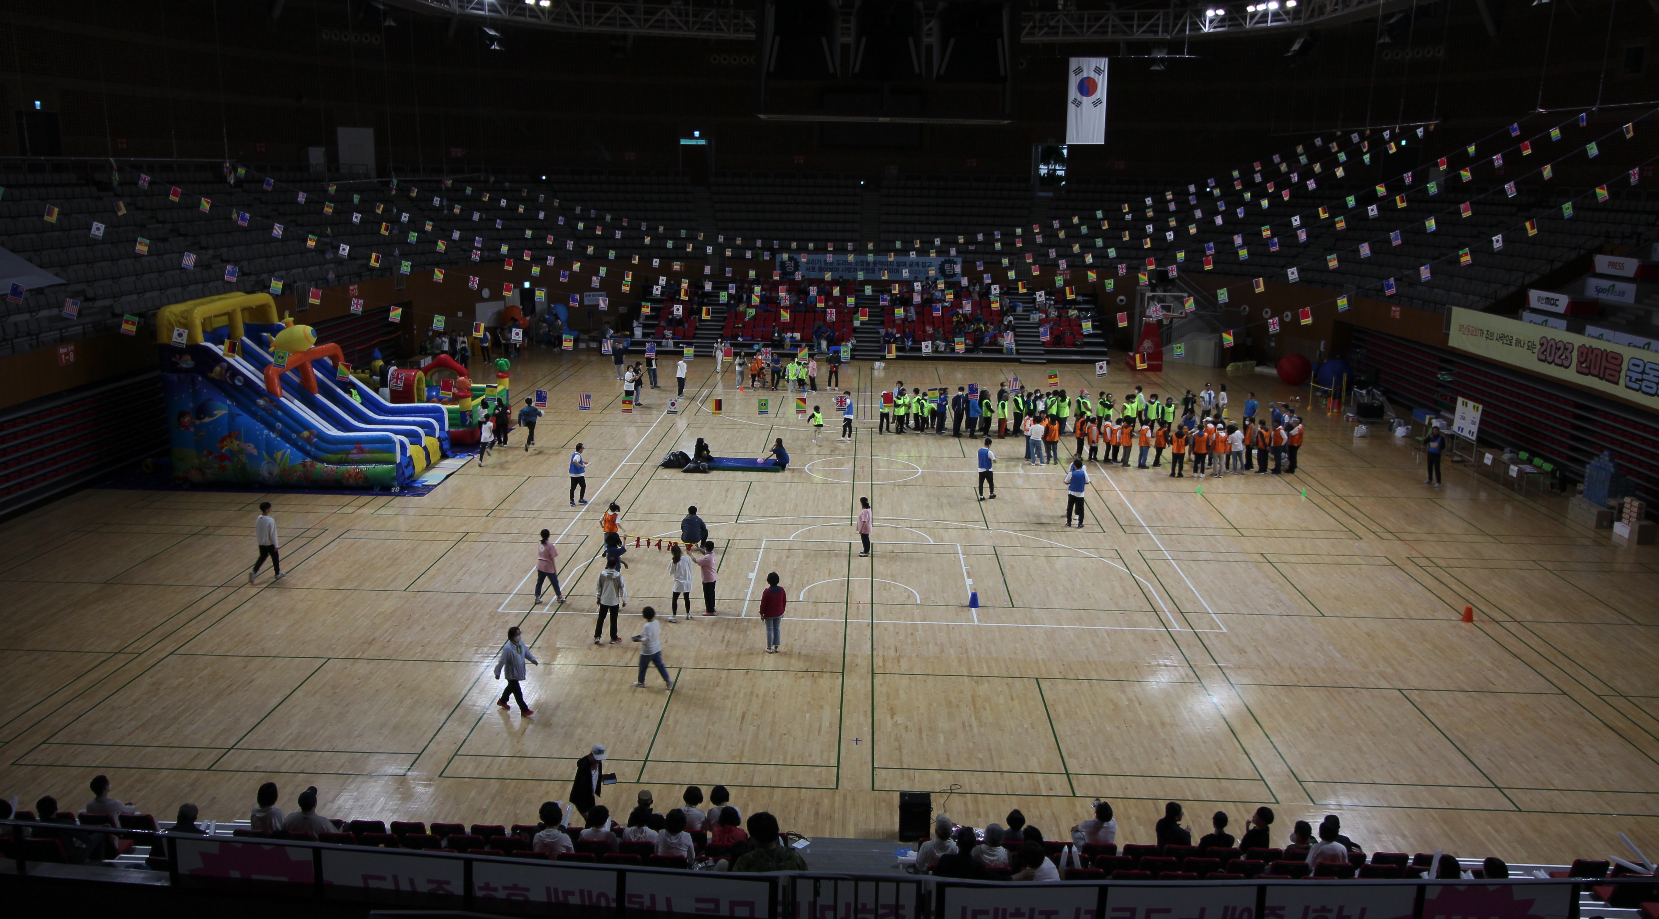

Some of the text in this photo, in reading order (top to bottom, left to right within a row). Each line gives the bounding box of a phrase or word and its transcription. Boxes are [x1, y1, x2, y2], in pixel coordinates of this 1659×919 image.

[944, 263, 954, 275] 팀
[1607, 261, 1625, 271] PRESS
[61, 351, 74, 364] 1-8
[1495, 332, 1514, 347] 사랑으로
[1514, 337, 1526, 348] 하나
[1526, 340, 1537, 354] 되는
[1537, 335, 1575, 369] 2023
[1575, 343, 1623, 385] 한마음
